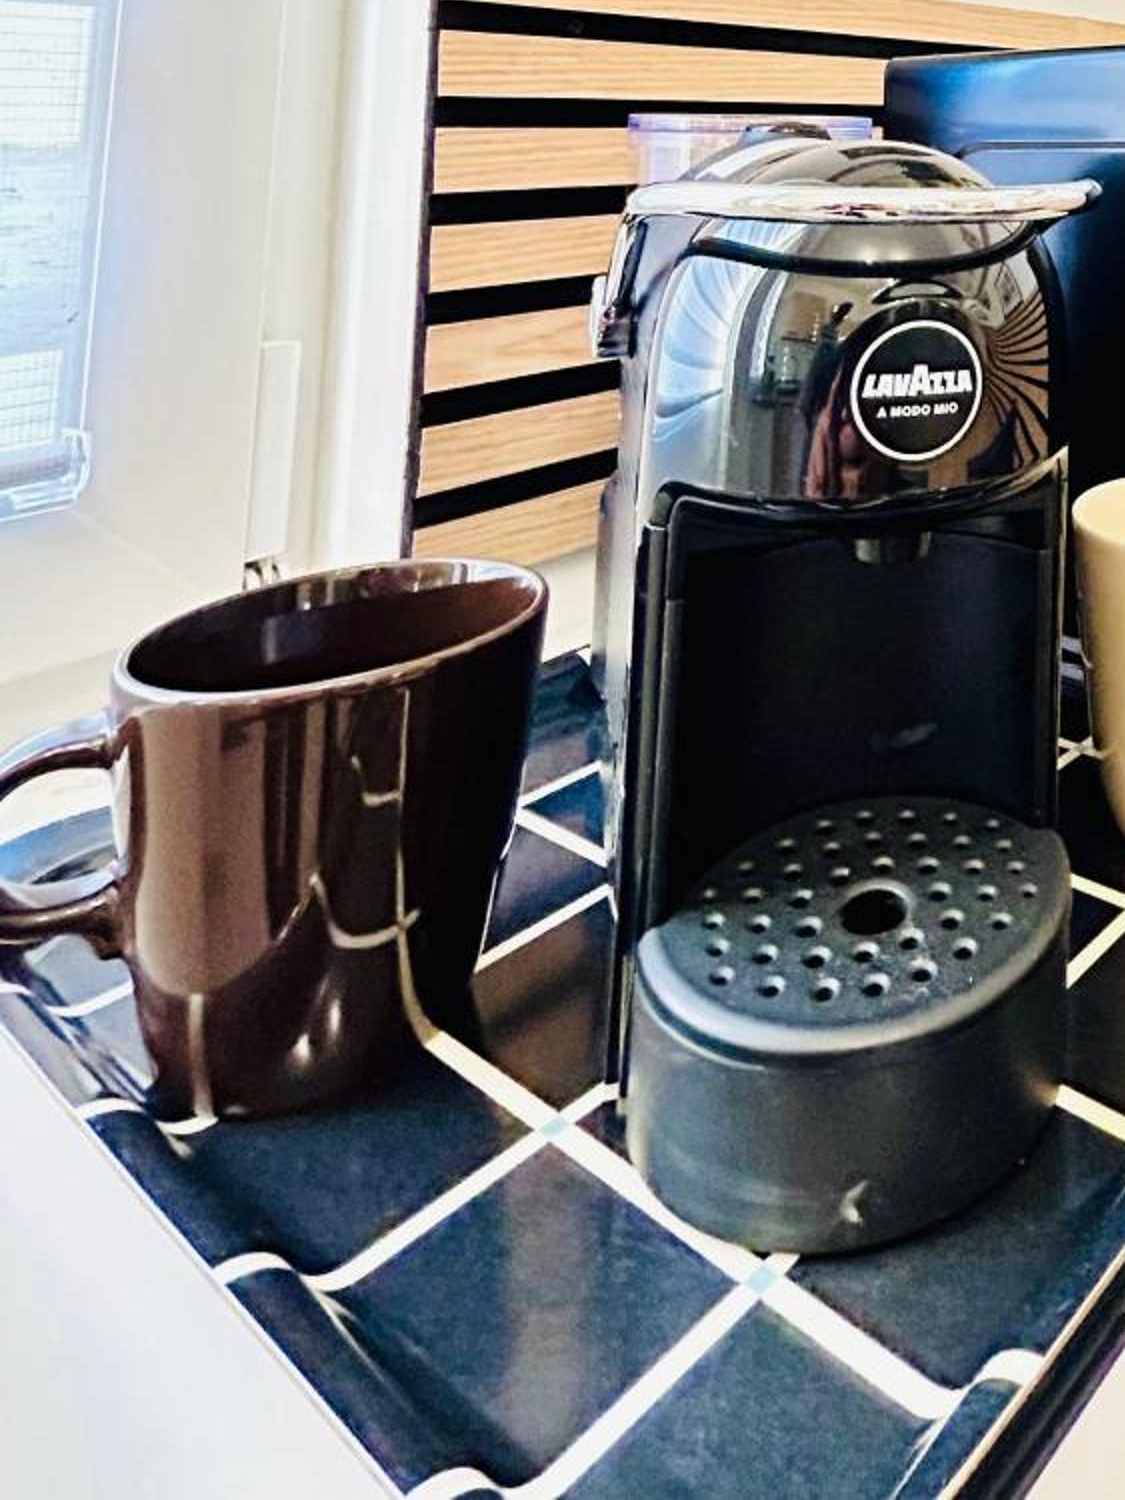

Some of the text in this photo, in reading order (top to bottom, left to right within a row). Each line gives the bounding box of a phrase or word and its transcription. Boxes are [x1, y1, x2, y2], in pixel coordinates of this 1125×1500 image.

[861, 363, 973, 399] LAVAZZA
[876, 401, 959, 419] A MODO MIO
